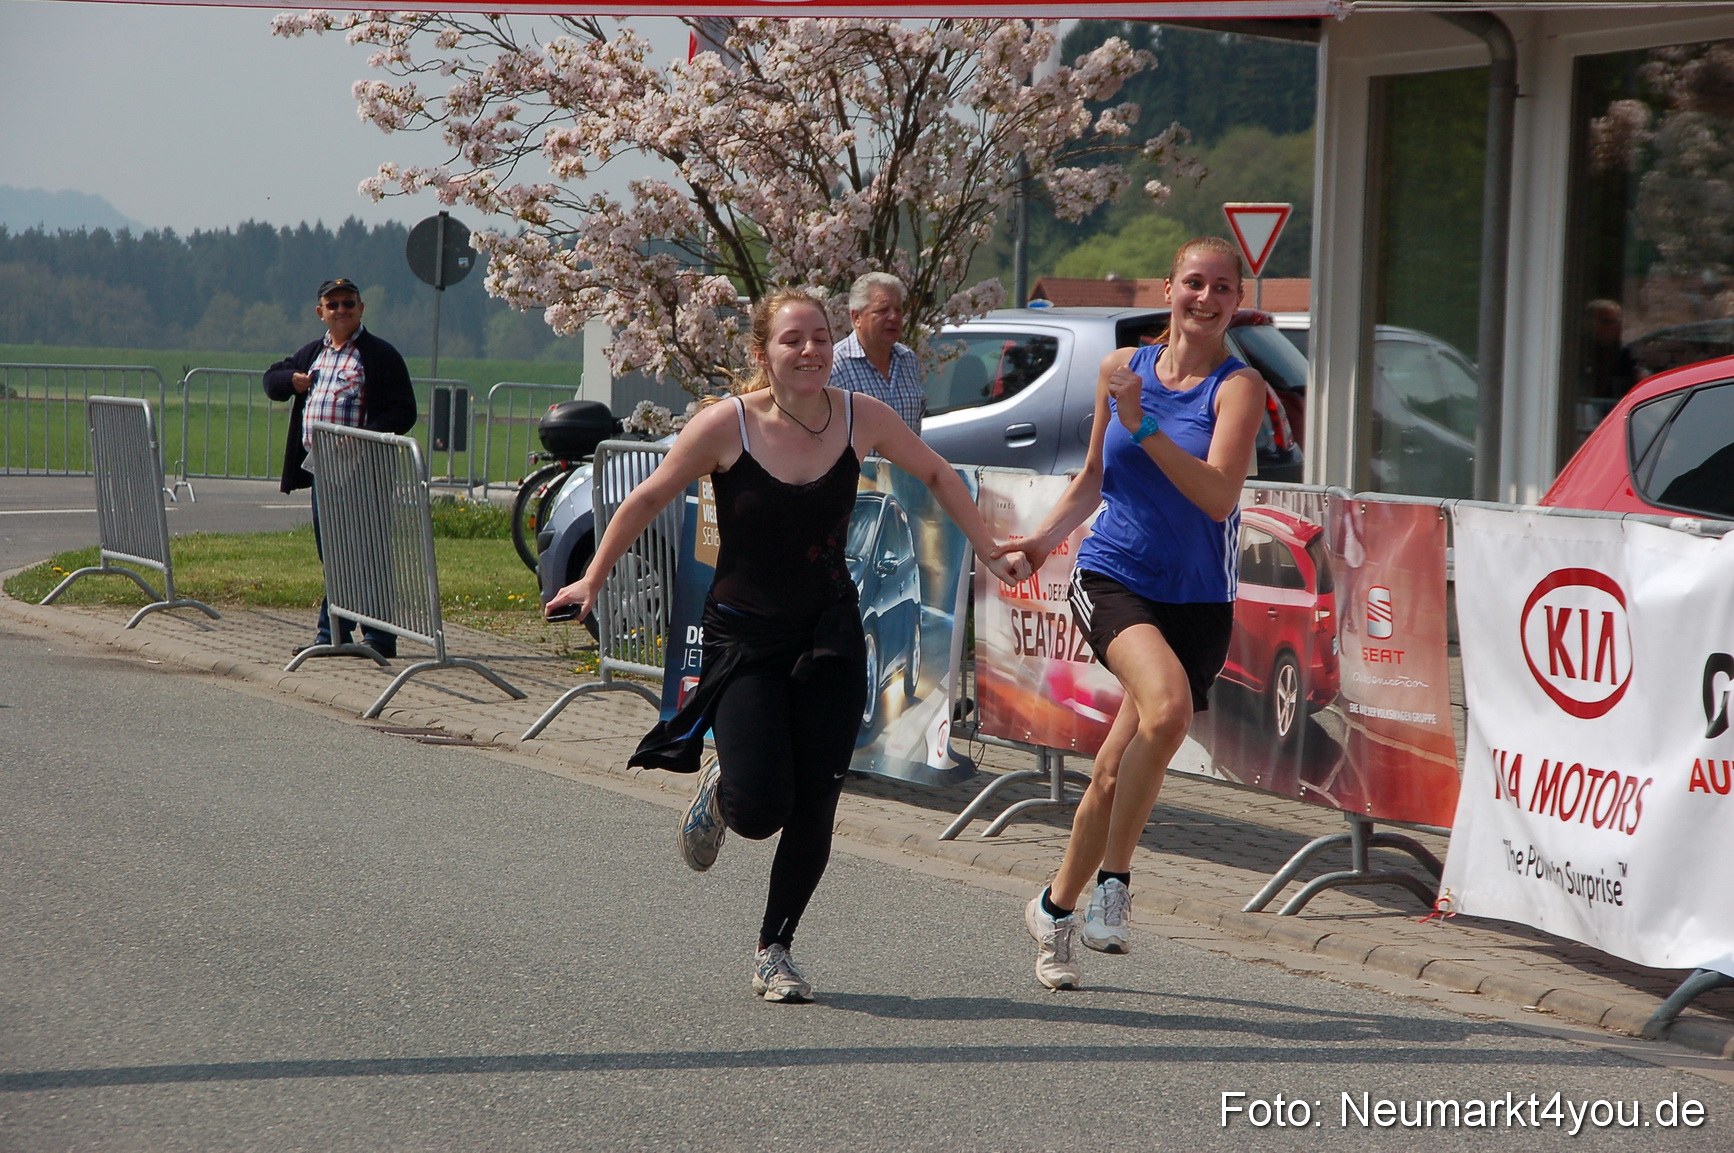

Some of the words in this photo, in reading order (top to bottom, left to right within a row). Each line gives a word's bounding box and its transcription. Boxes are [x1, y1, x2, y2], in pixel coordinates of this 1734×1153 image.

[1362, 647, 1405, 664] SEAT
[1544, 605, 1617, 686] KIA
[1413, 712, 1437, 724] GRUPPE
[1529, 759, 1653, 835] MOTORS
[1688, 758, 1734, 795] AU
[1503, 839, 1523, 875] The
[1565, 861, 1623, 908] Surprise
